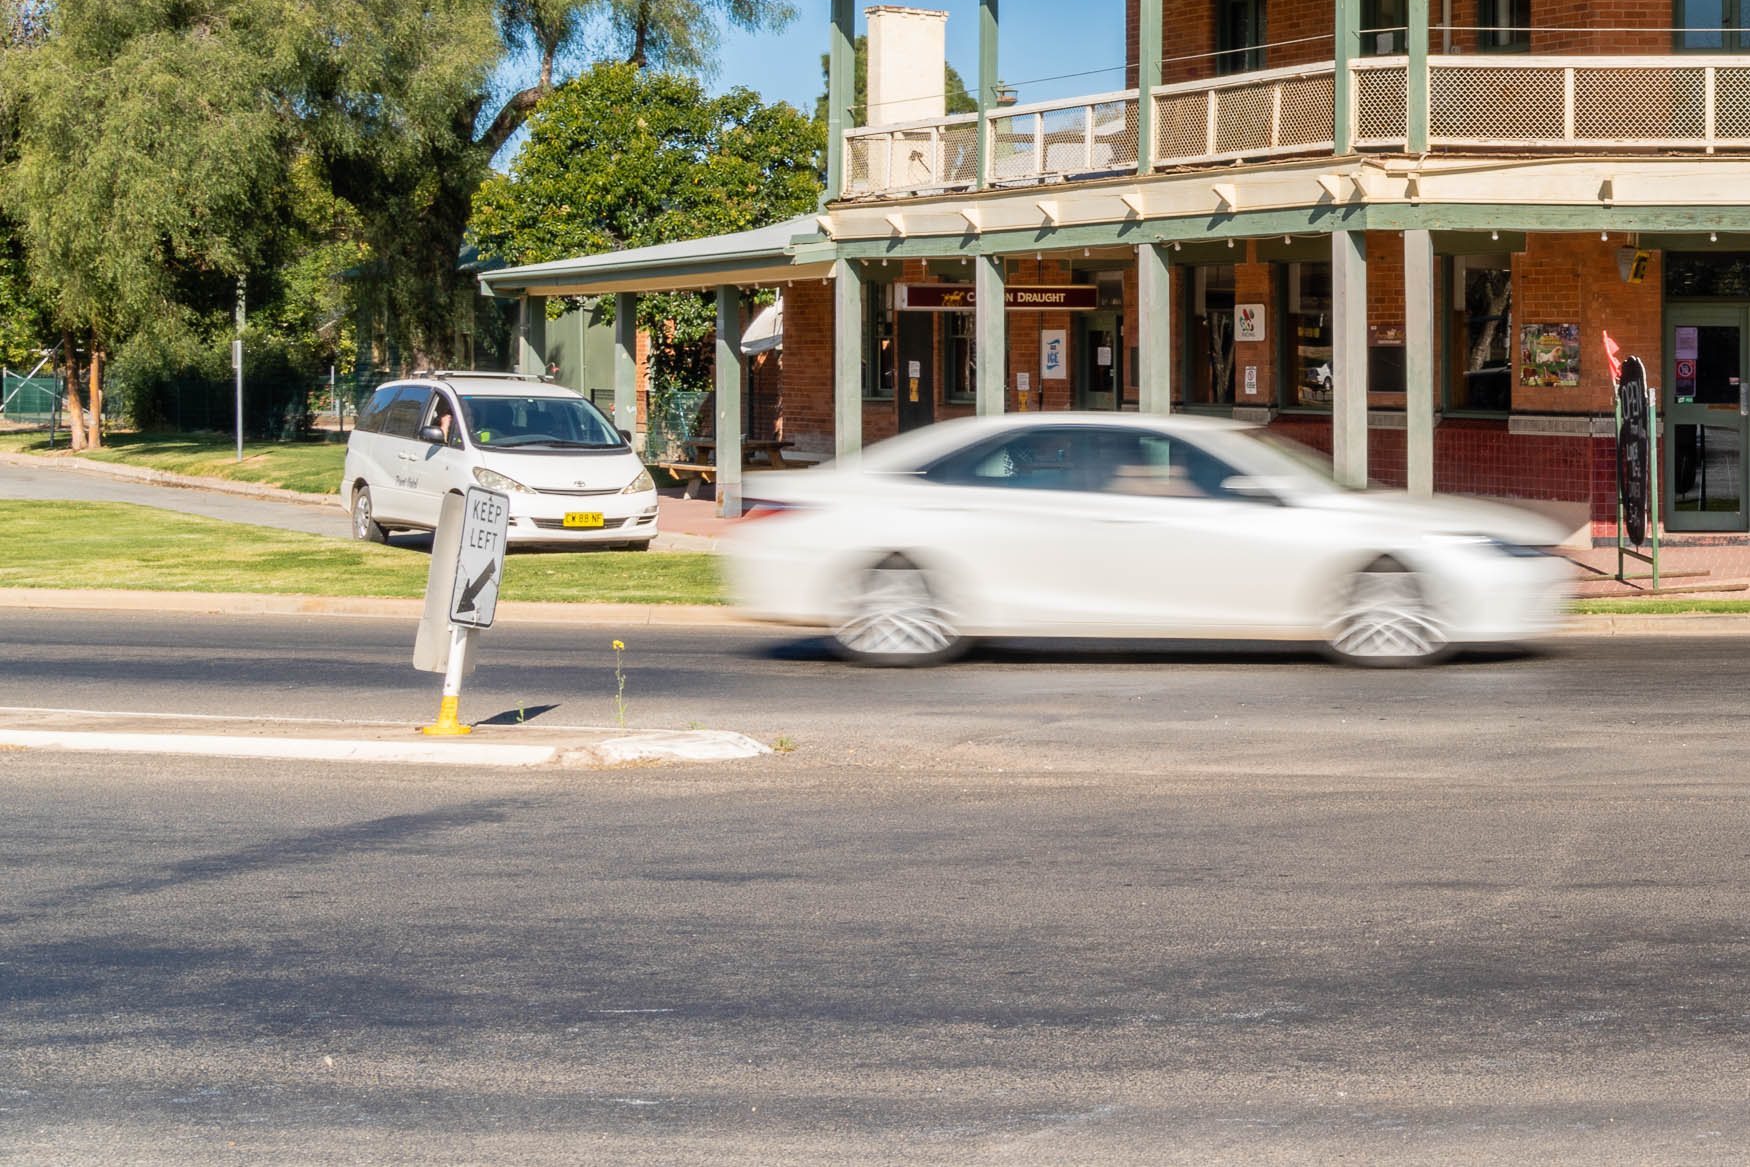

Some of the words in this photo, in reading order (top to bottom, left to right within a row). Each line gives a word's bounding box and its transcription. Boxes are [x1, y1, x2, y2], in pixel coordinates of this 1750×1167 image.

[1017, 293, 1065, 303] DRAUGHT
[473, 499, 502, 524] KEEP
[470, 530, 498, 553] LEFT
